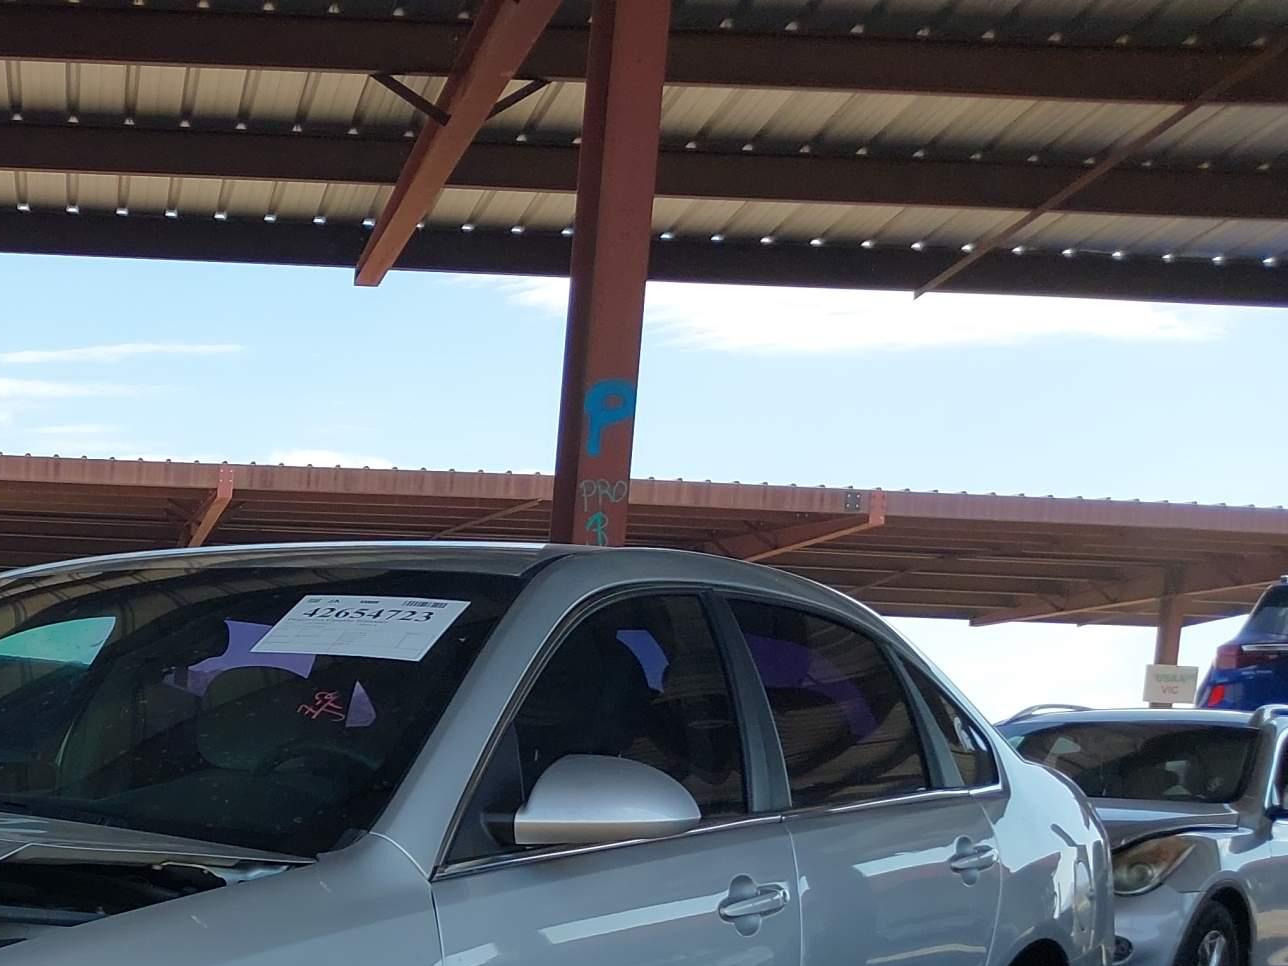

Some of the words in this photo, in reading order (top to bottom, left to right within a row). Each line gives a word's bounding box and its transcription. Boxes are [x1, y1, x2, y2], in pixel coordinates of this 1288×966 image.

[585, 380, 635, 456] P
[580, 480, 626, 511] PRO
[303, 607, 434, 622] 42654723
